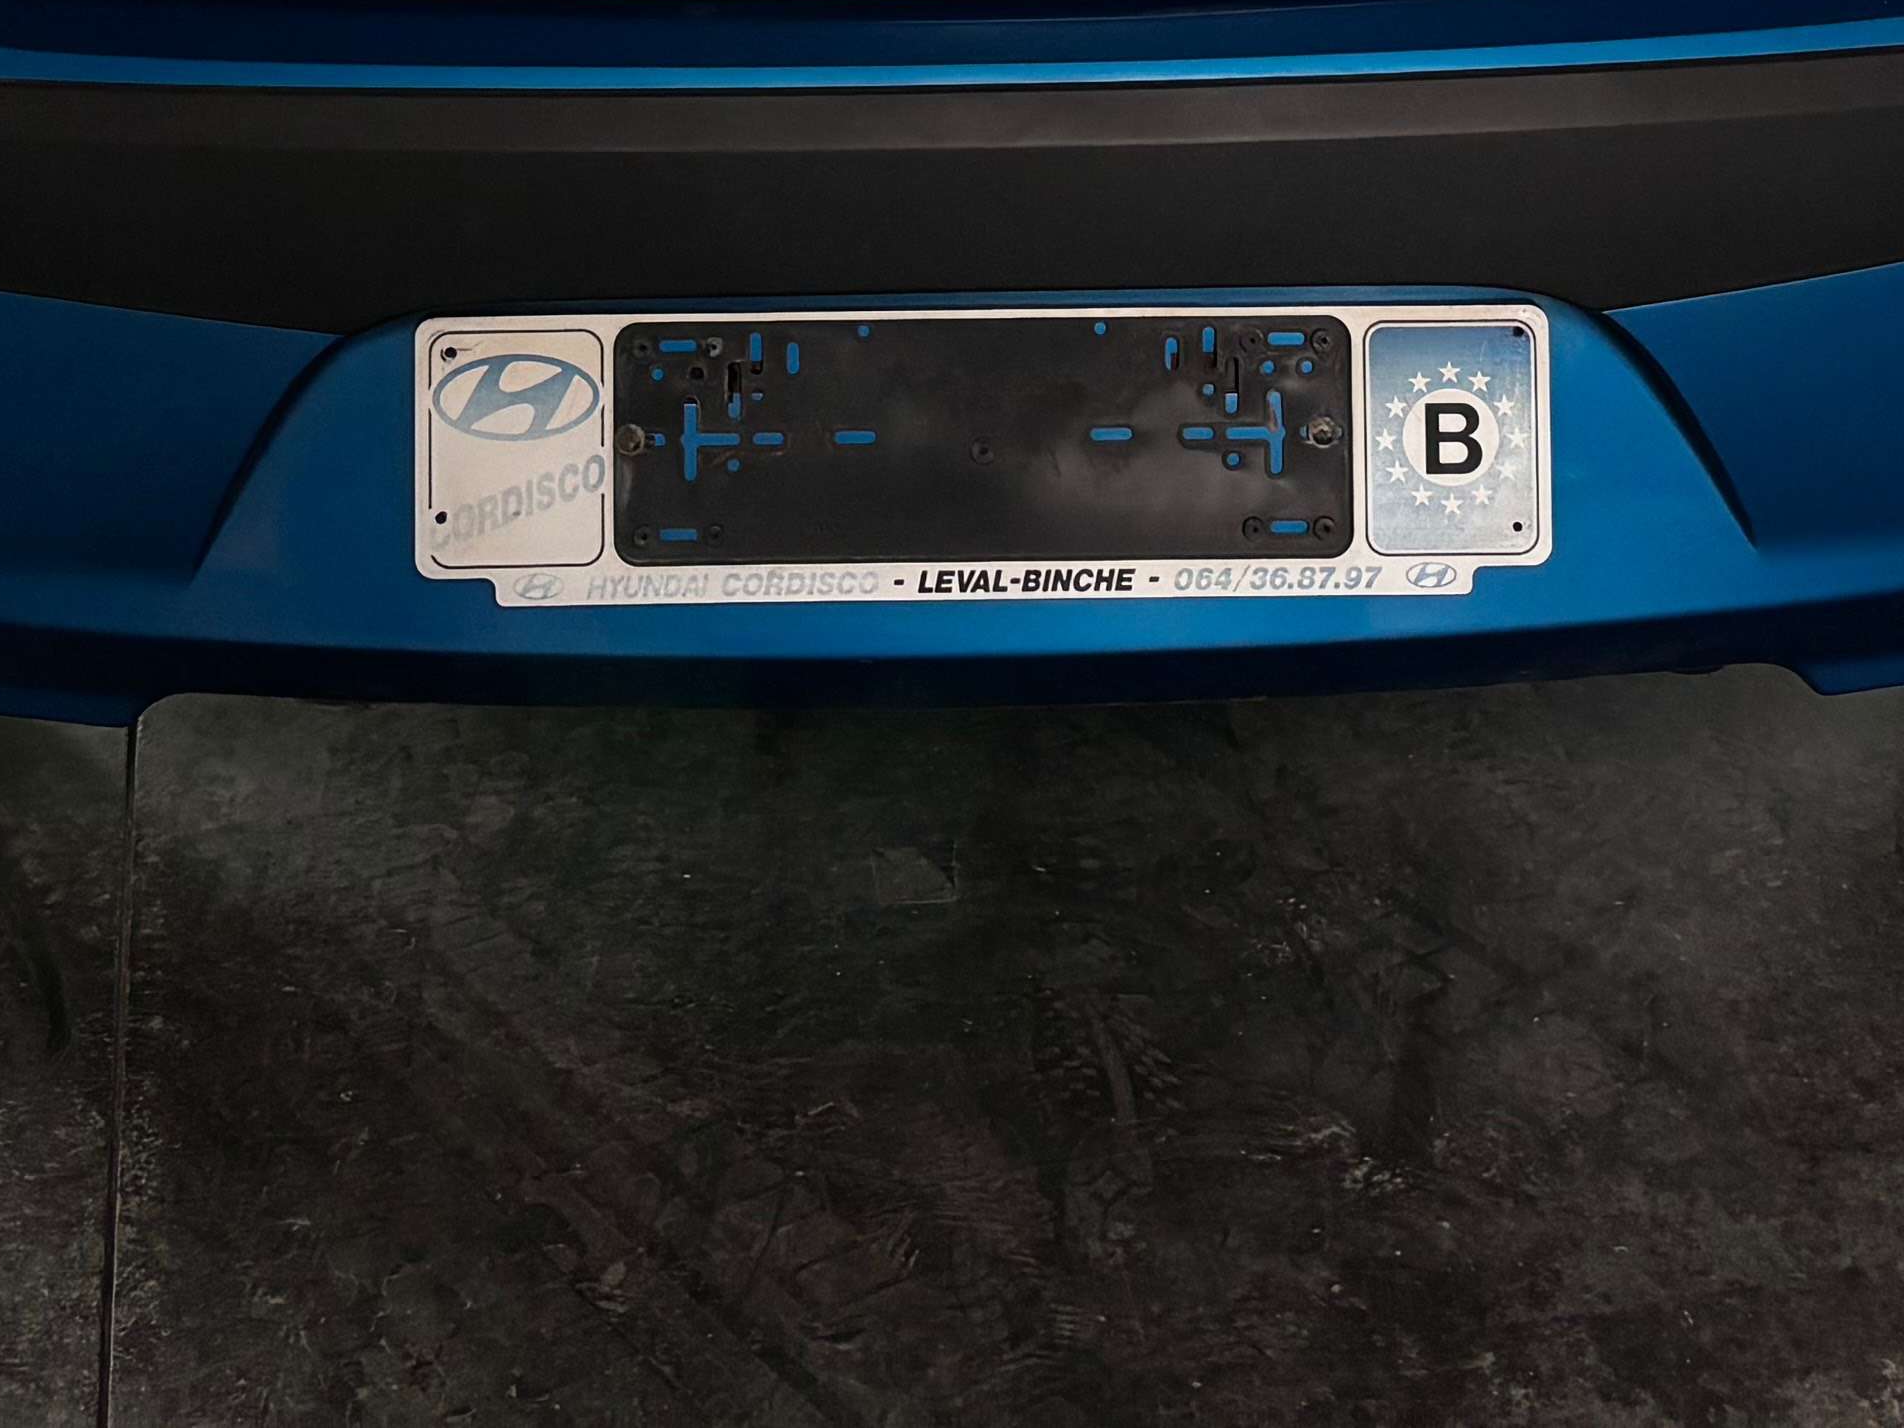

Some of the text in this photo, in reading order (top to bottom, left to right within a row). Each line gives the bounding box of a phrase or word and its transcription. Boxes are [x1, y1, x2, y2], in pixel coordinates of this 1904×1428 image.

[1424, 402, 1483, 475] B
[586, 573, 709, 600] HYUNDAI
[720, 569, 880, 598] CORDISCO
[917, 568, 1137, 594] LEVAL-BINCHE
[1173, 564, 1383, 592] 064/36.87.97
